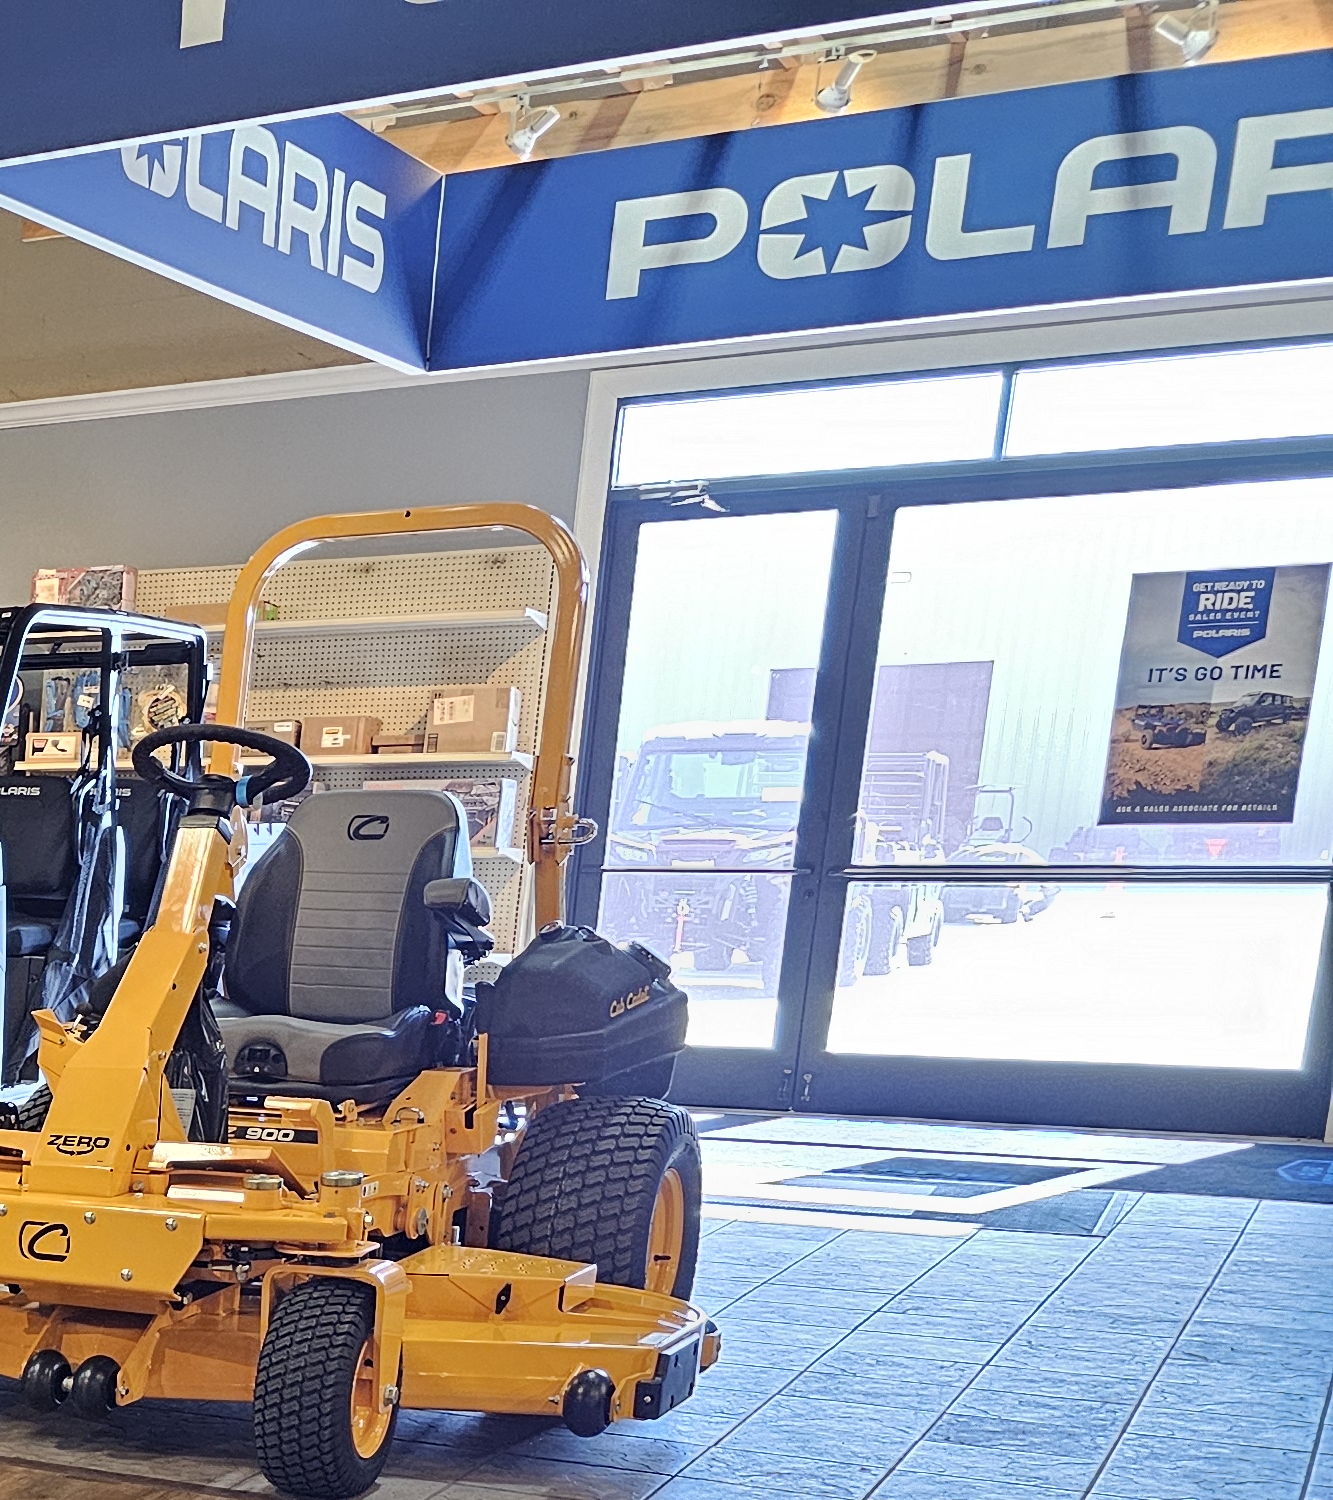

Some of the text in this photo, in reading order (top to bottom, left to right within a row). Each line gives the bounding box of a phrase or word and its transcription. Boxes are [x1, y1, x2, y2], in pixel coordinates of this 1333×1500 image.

[1193, 579, 1265, 592] GET READY TO
[1198, 591, 1255, 611] RIDE
[1189, 611, 1260, 621] SALES EVENT
[1193, 628, 1251, 639] POLARIS
[1147, 663, 1284, 683] IT'S GO TIME
[609, 997, 625, 1018] Cub
[46, 1134, 111, 1150] ZERO
[245, 1128, 295, 1142] 900
